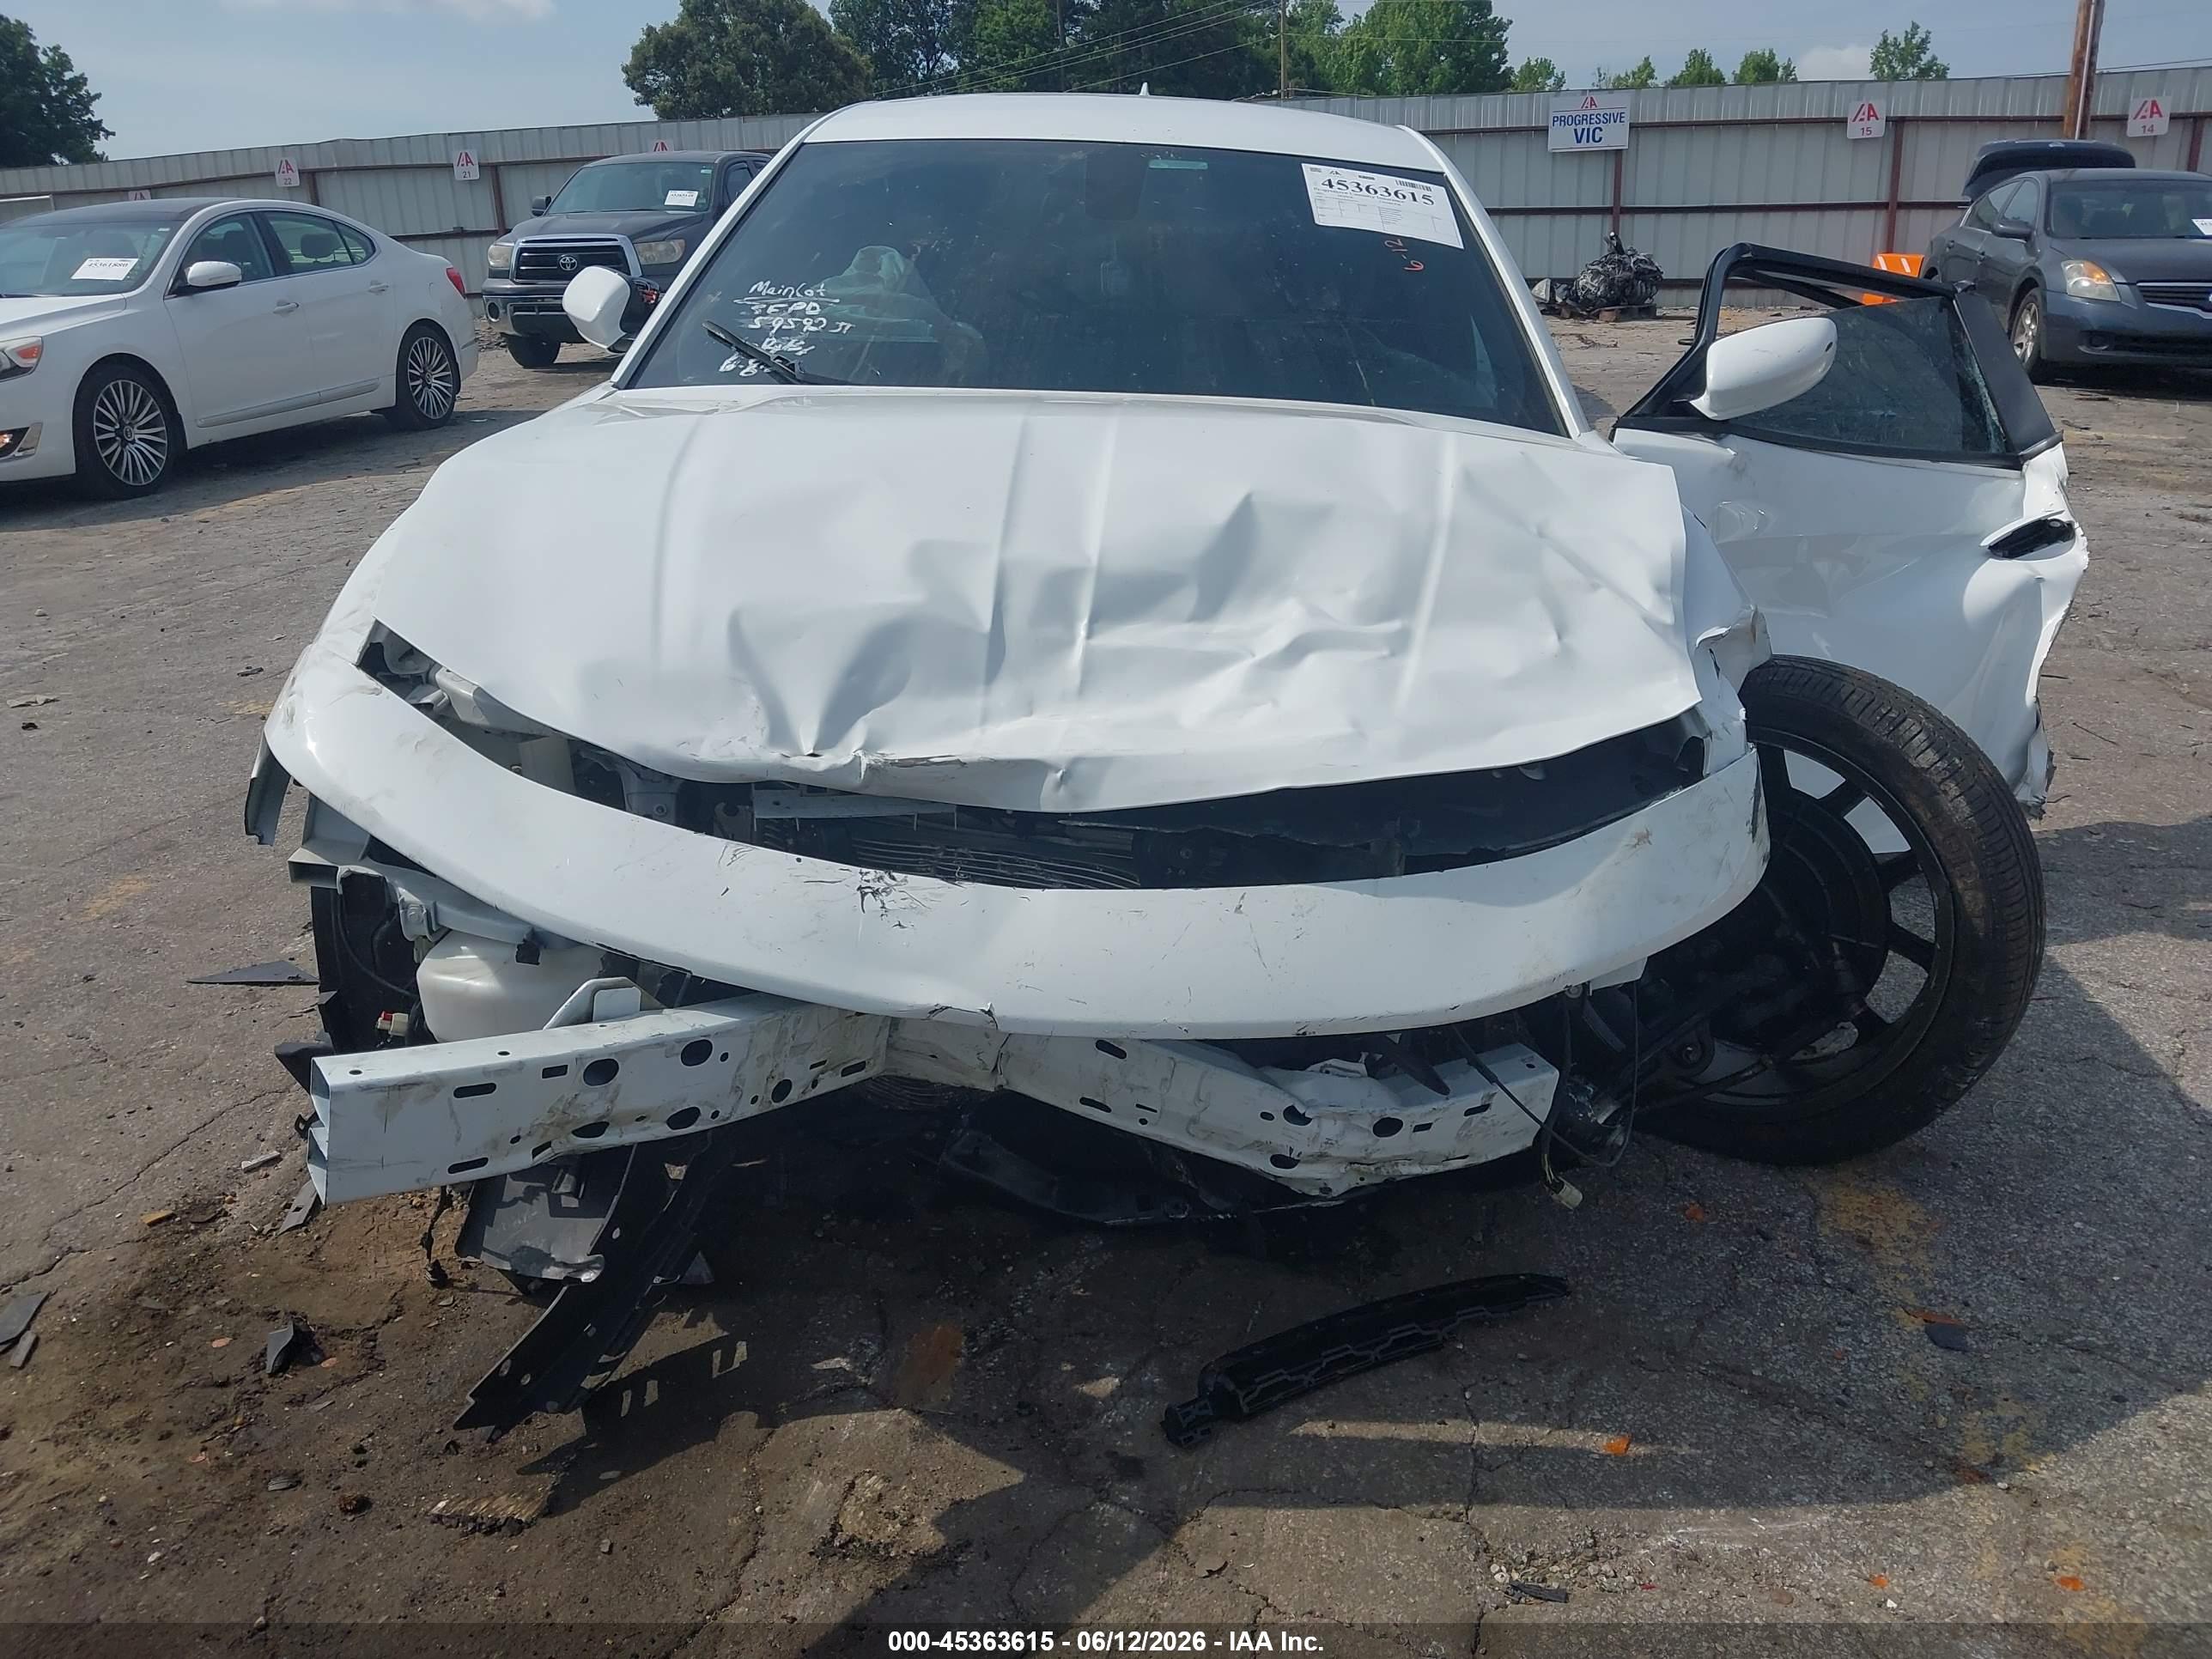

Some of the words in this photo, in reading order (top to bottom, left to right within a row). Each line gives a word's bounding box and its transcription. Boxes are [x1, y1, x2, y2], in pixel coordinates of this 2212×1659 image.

[1552, 112, 1626, 127] PROGRESSIVE
[1573, 126, 1604, 144] VIC
[1860, 126, 1873, 136] 15
[2141, 124, 2154, 135] 14
[1321, 178, 1435, 206] 45363615
